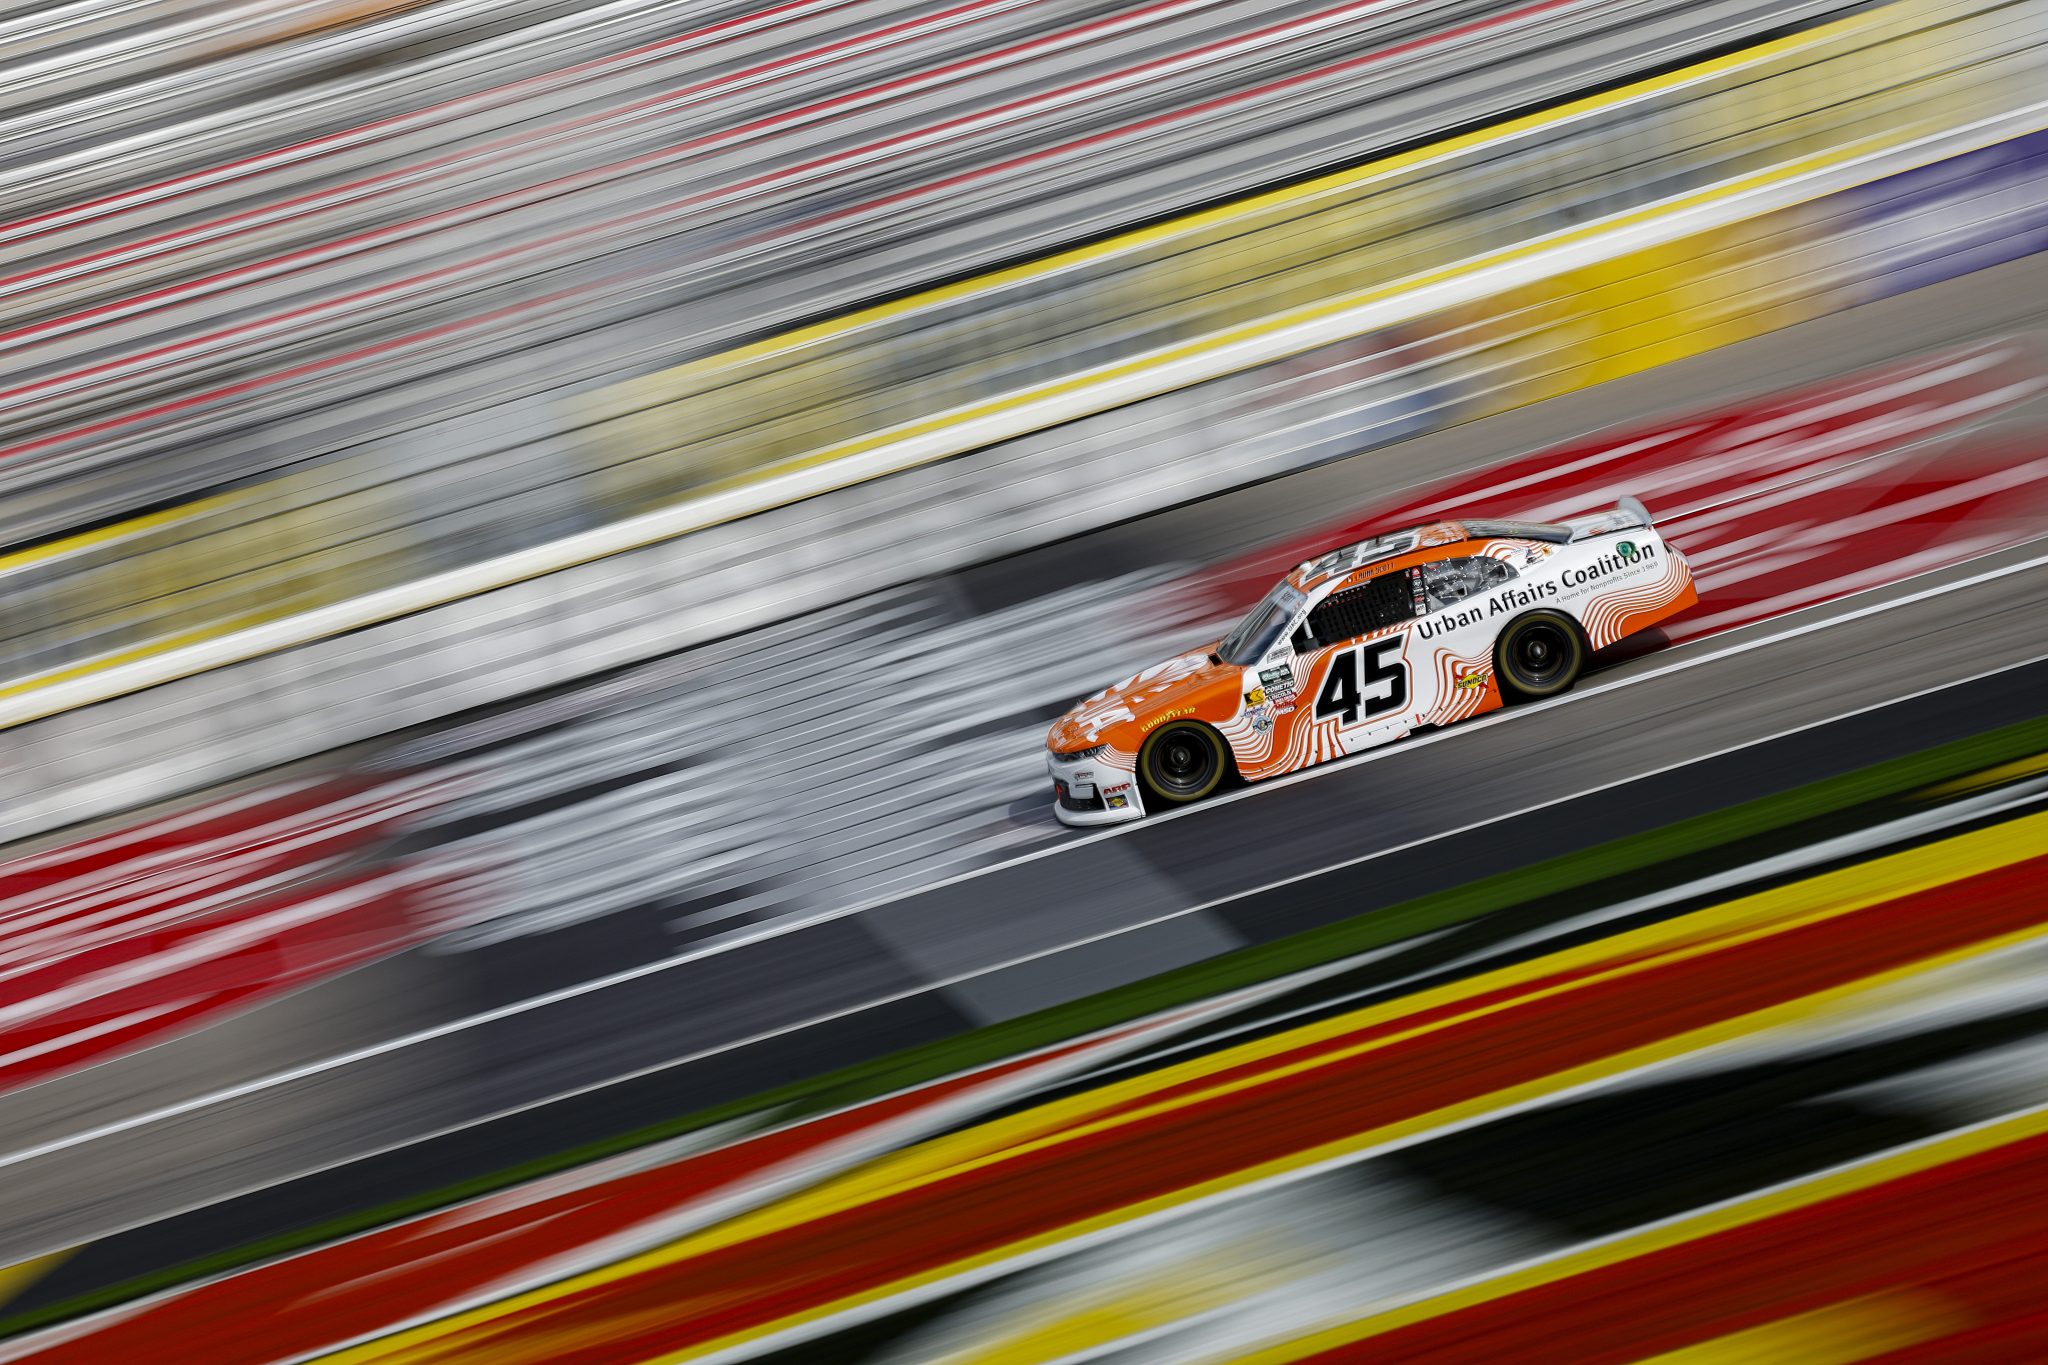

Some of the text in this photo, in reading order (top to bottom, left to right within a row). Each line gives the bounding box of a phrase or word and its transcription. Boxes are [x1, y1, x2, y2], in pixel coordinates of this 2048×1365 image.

[1417, 543, 1655, 640] Urban Affairs Coalition
[1561, 591, 1579, 603] Home
[1580, 587, 1590, 596] for
[1590, 574, 1622, 592] Nonprofits
[1623, 569, 1640, 579] Since
[1642, 561, 1658, 573] 1969
[1266, 680, 1294, 694] COMETIC
[1316, 634, 1406, 726] 45
[1457, 674, 1487, 689] SUNOCO
[1141, 707, 1196, 733] GOODYEAR
[1103, 782, 1131, 795] ARP
